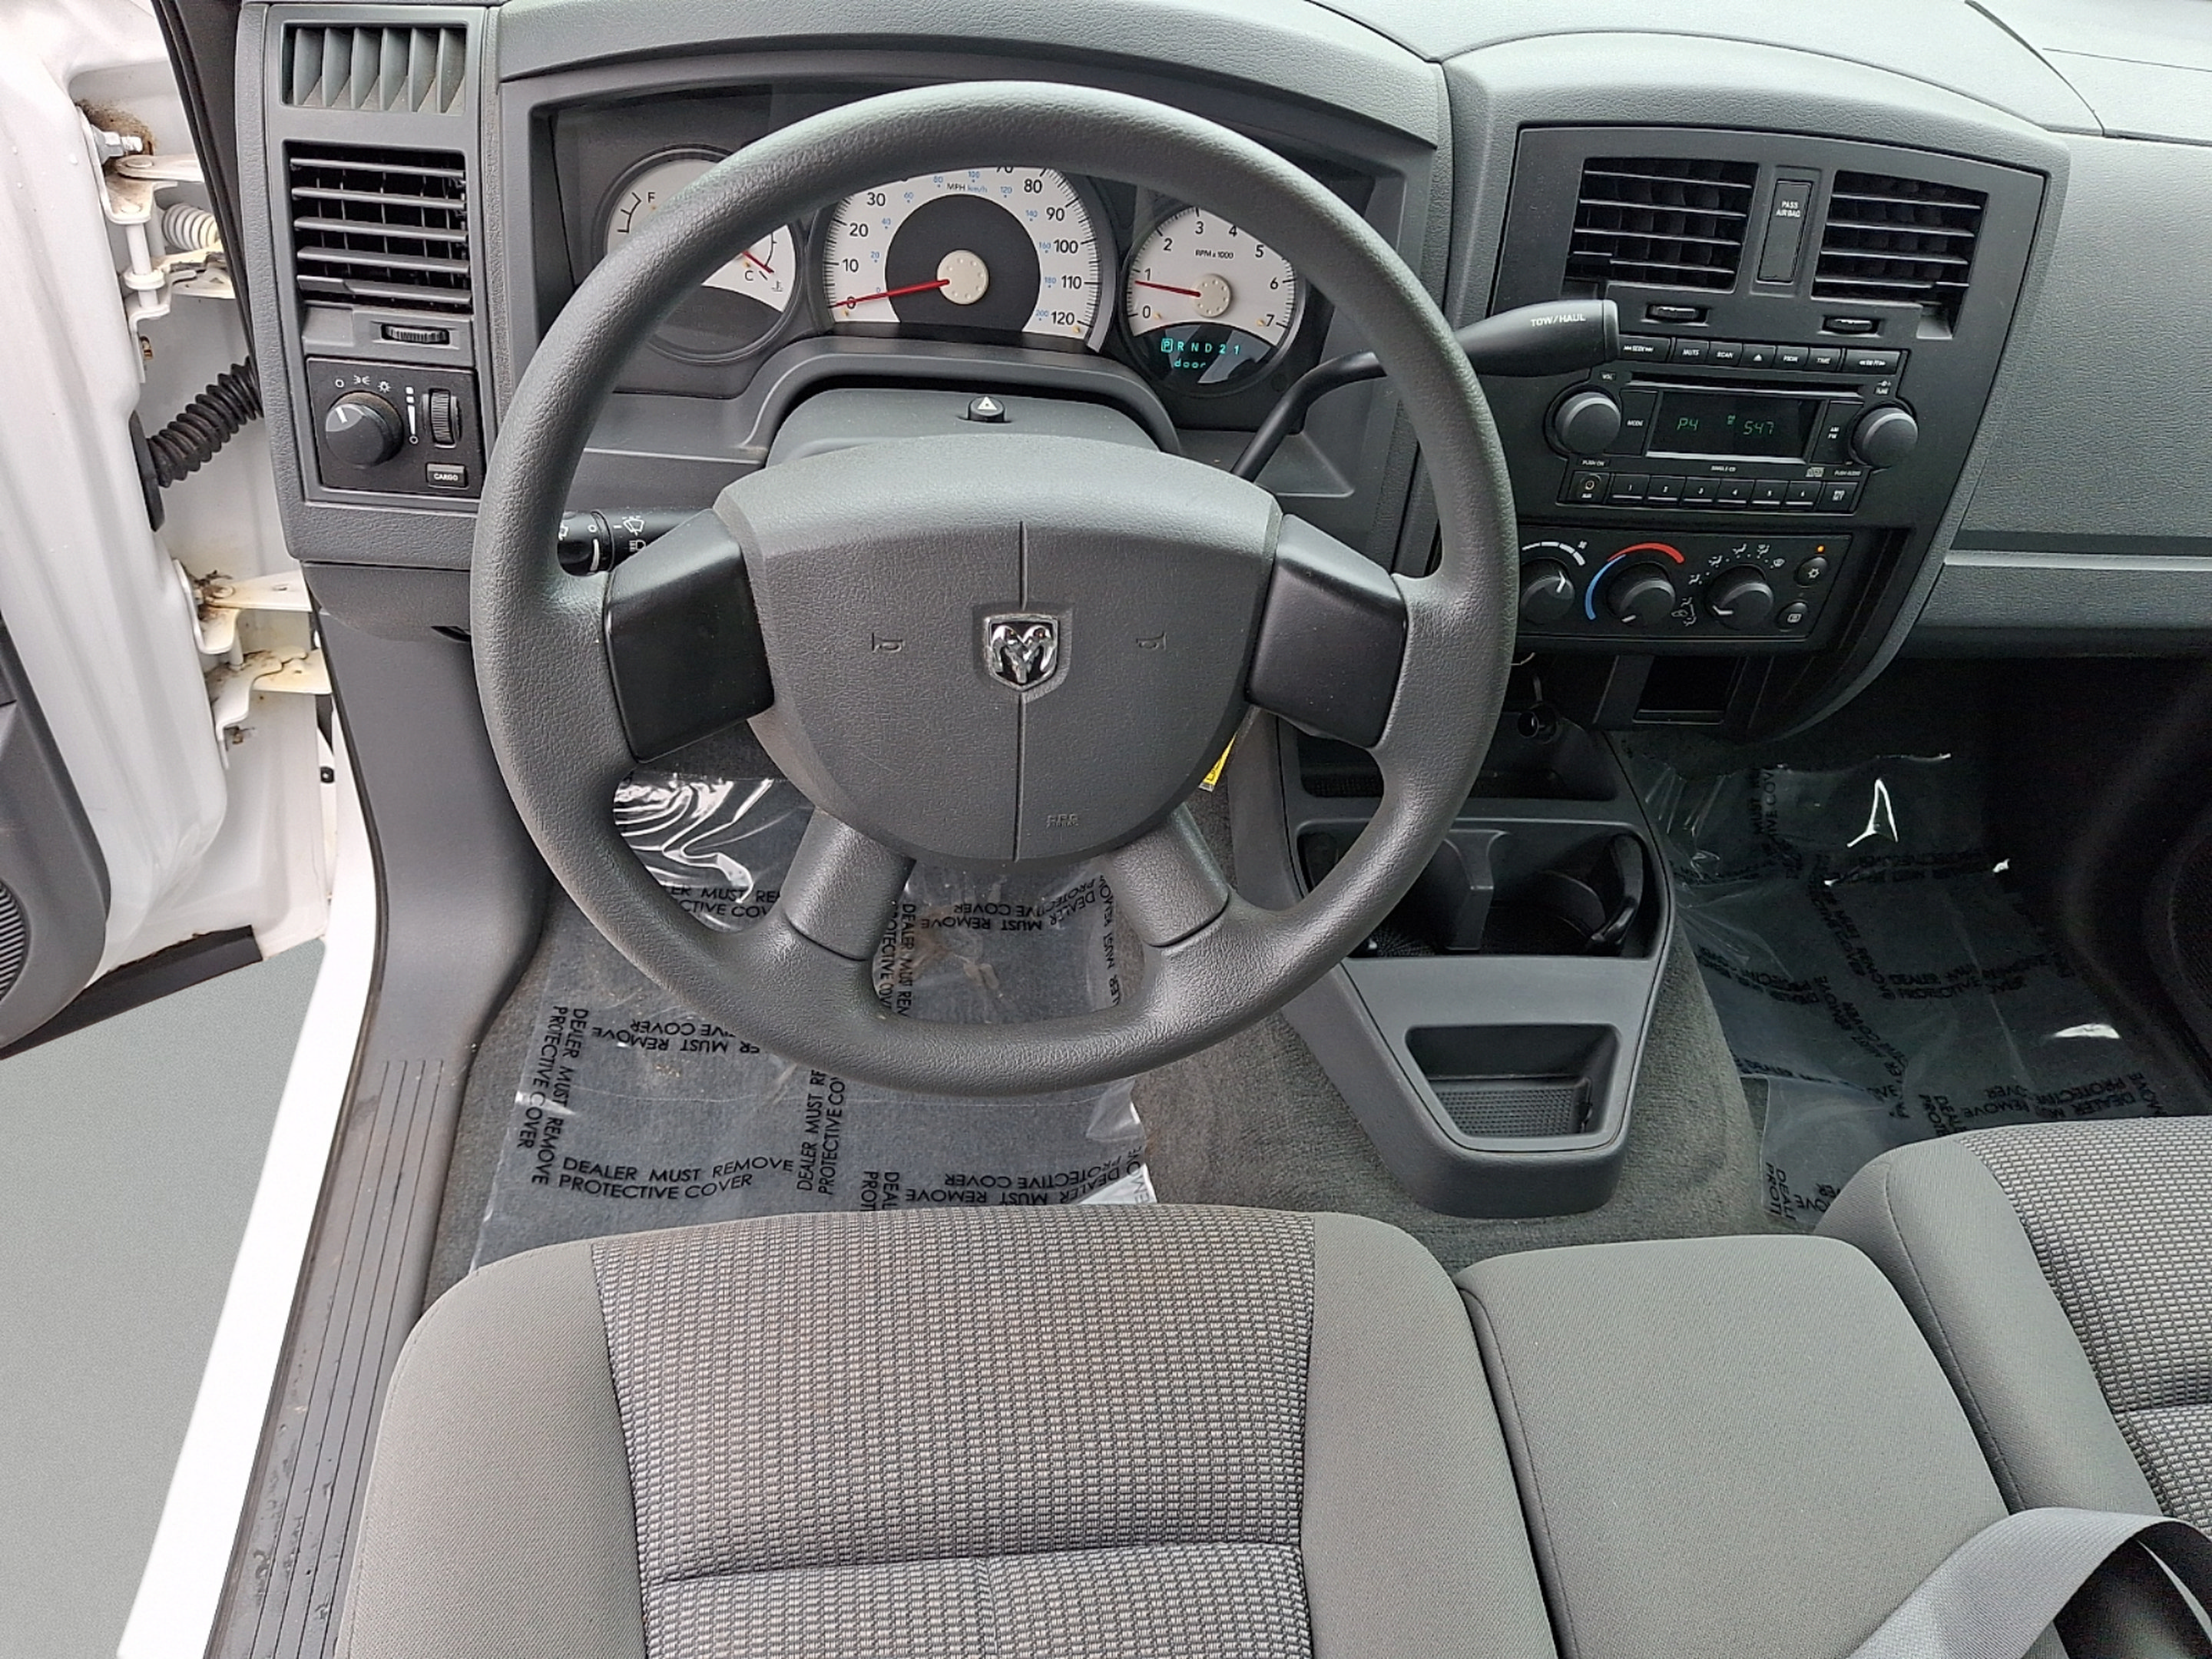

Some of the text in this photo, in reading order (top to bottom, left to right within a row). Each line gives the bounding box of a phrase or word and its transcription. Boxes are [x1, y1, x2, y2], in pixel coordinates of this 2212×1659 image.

[1024, 178, 1042, 193] 80
[647, 192, 655, 203] F
[866, 192, 886, 207] 30
[1782, 200, 1799, 209] PASS
[1046, 207, 1065, 221] 90
[1776, 209, 1800, 217] AIRBAG
[849, 224, 869, 237] 20
[1194, 220, 1204, 234] 3
[1229, 225, 1237, 237] 4
[1053, 239, 1078, 253] 100
[1163, 237, 1173, 251] 2
[1254, 244, 1264, 258] 5
[843, 259, 859, 273] 10
[744, 270, 753, 281] C
[1144, 268, 1151, 280] 1
[1061, 275, 1081, 289] 110
[1270, 277, 1279, 290] 6
[846, 296, 856, 310] 0
[1051, 311, 1075, 326] 120
[1142, 305, 1151, 318] 0
[1266, 314, 1275, 326] 7
[1530, 313, 1586, 326] TOW/HAUL
[1163, 340, 1240, 355] P R N D 2 1
[1174, 359, 1207, 369] door
[700, 888, 747, 902] MUST
[953, 902, 1011, 916] COVER
[922, 918, 991, 931] REMOVE
[1001, 919, 1042, 931] MUST
[631, 1018, 696, 1035] COVER
[591, 1026, 670, 1051] REMOVE
[679, 1039, 729, 1053] MUST
[516, 1005, 568, 1149] PROTECTIVE COVER
[531, 1008, 589, 1185] DEALER MUST REMOVE
[806, 1094, 823, 1134] MUST
[818, 1108, 843, 1196] PROTECTIVE
[563, 1157, 794, 1182] DEALER MUST REMOVE
[797, 1141, 817, 1191] DEALER
[558, 1174, 753, 1200] PROTECTIVE COVER
[945, 1173, 1012, 1189] COVER
[906, 1188, 987, 1204] REMOVE
[999, 1193, 1048, 1205] MUST
